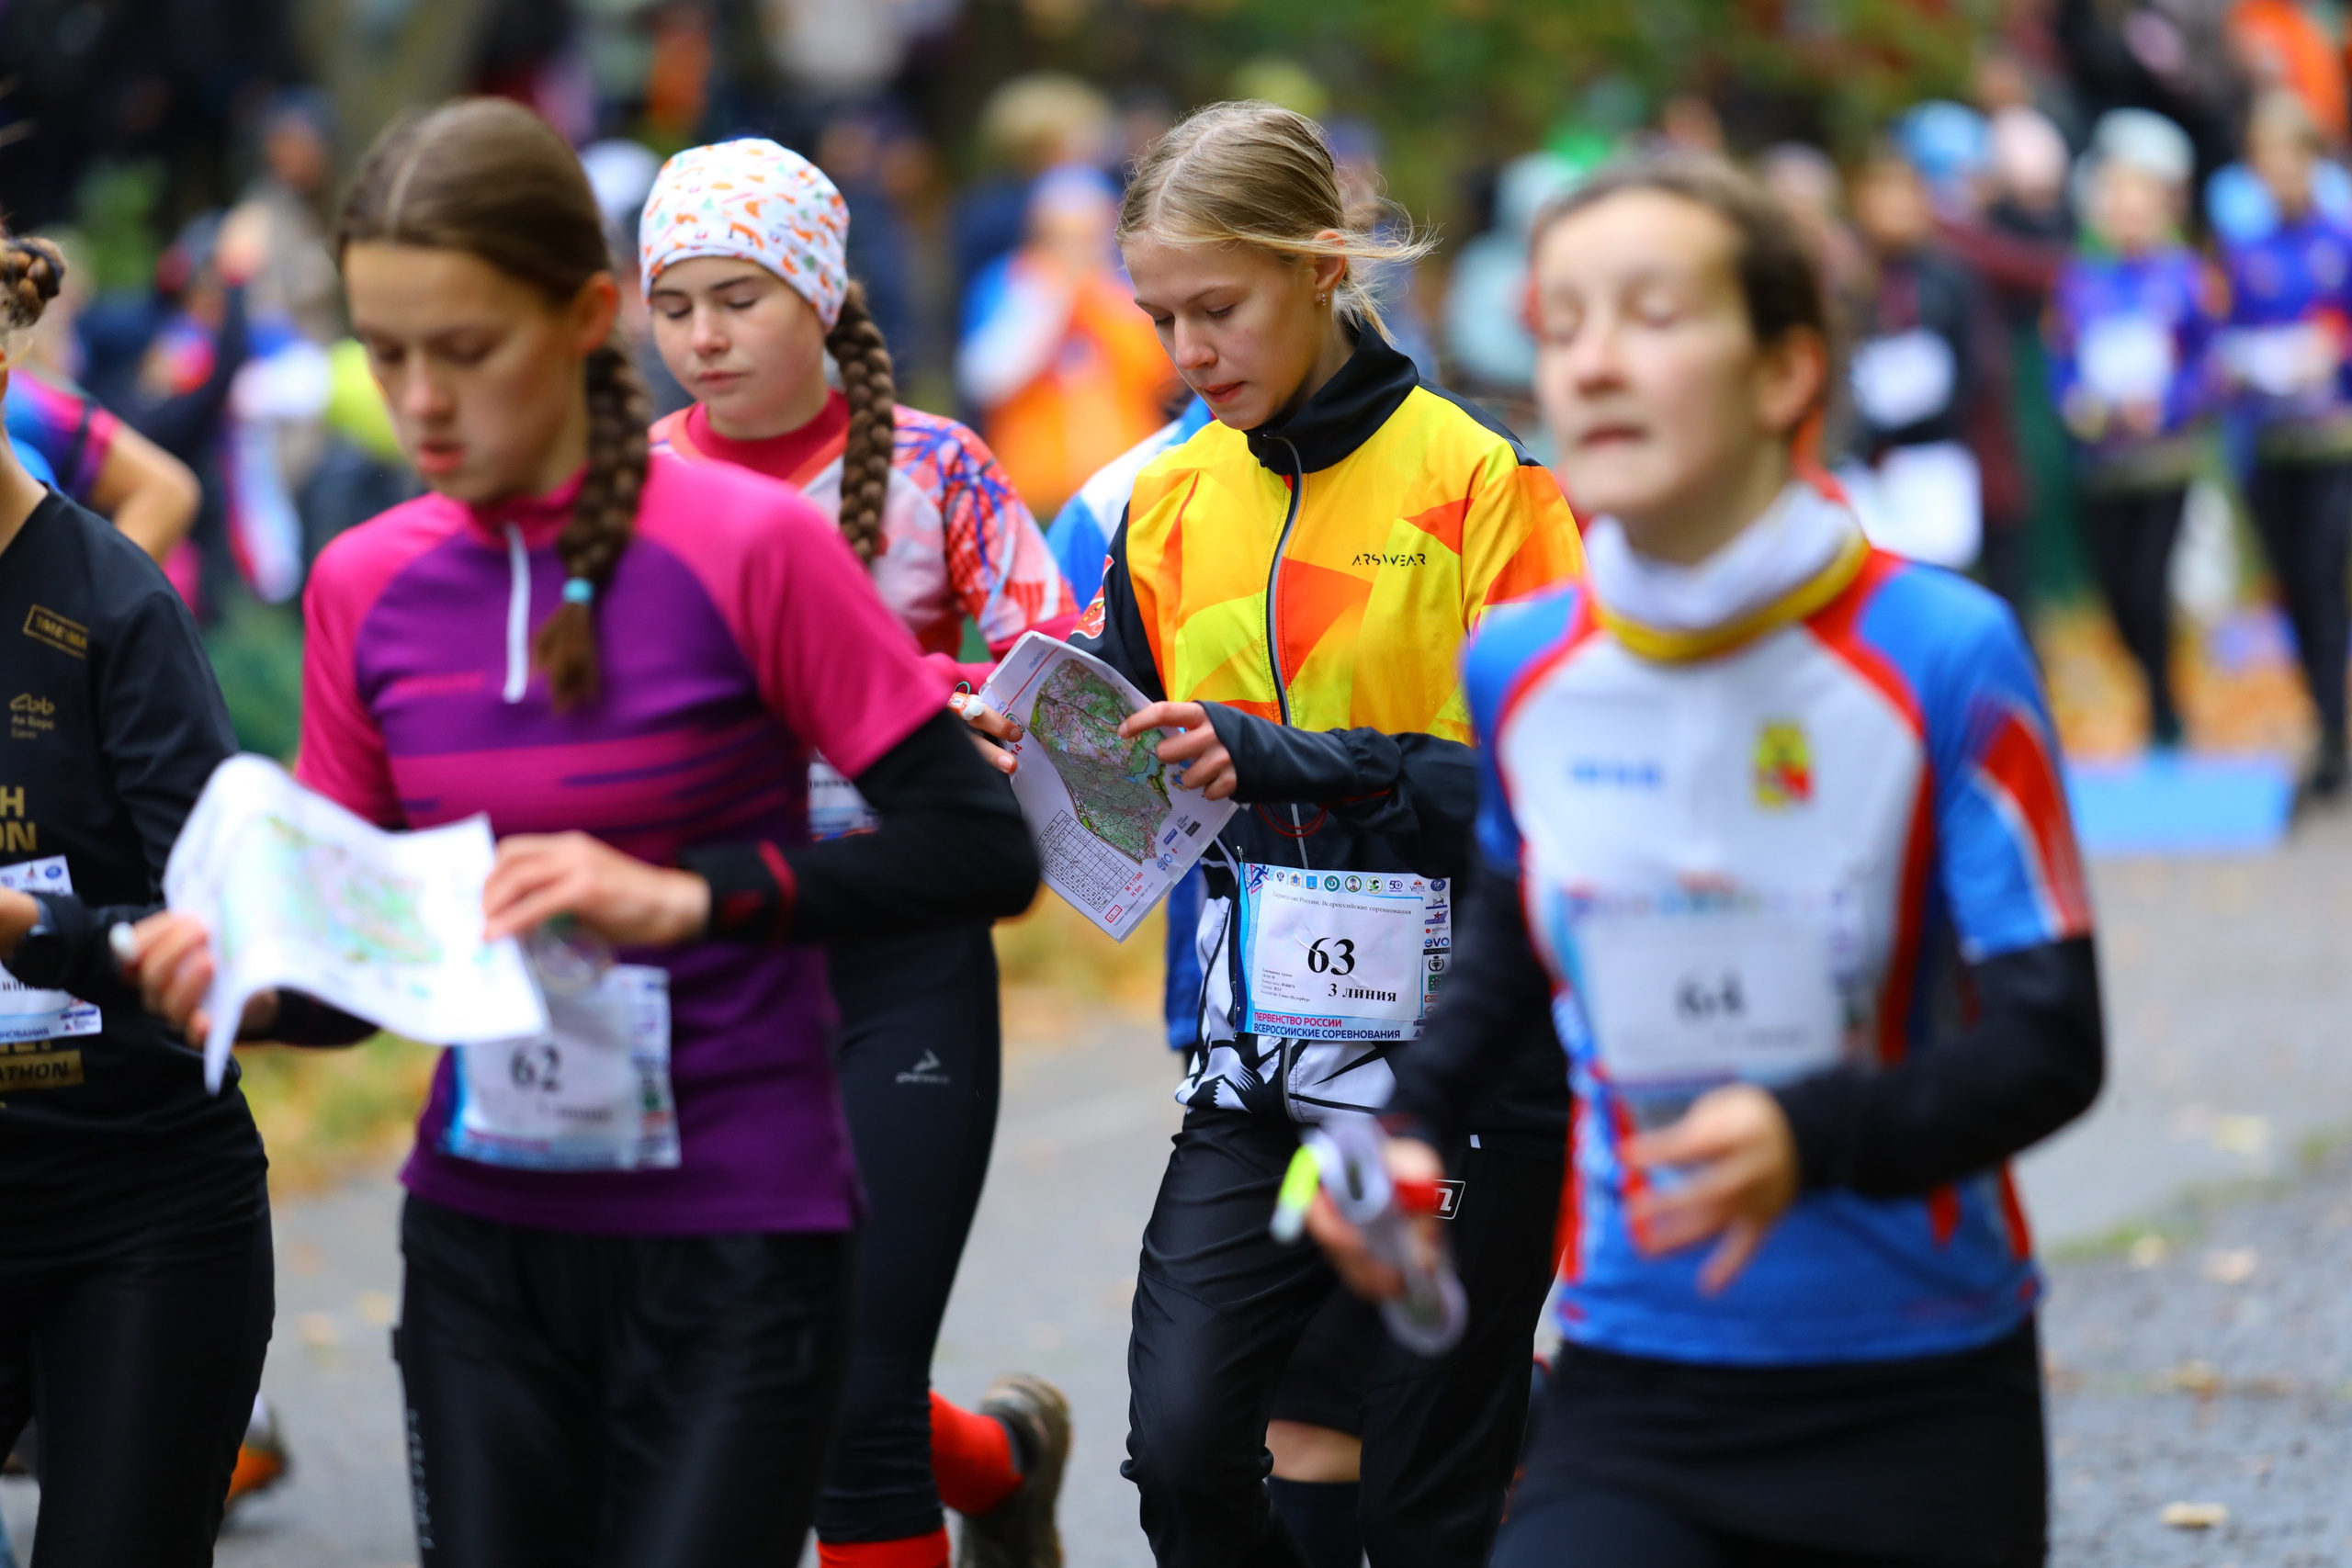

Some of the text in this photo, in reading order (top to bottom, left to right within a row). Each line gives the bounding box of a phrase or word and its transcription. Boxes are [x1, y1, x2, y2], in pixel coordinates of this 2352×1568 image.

[1351, 553, 1426, 567] ARSWEAR
[1299, 897, 1321, 906] России,
[1322, 900, 1368, 911] Всероссийские
[1369, 906, 1412, 915] соревнования
[1424, 937, 1450, 947] evo
[1307, 937, 1355, 976] 63
[1328, 983, 1396, 1002] 3 линия
[1254, 1011, 1342, 1028] ПЕРВЕНСТВО РОССИИ
[1322, 1028, 1401, 1039] СОРЕВНОВАНИЯ
[510, 1043, 561, 1093] 62
